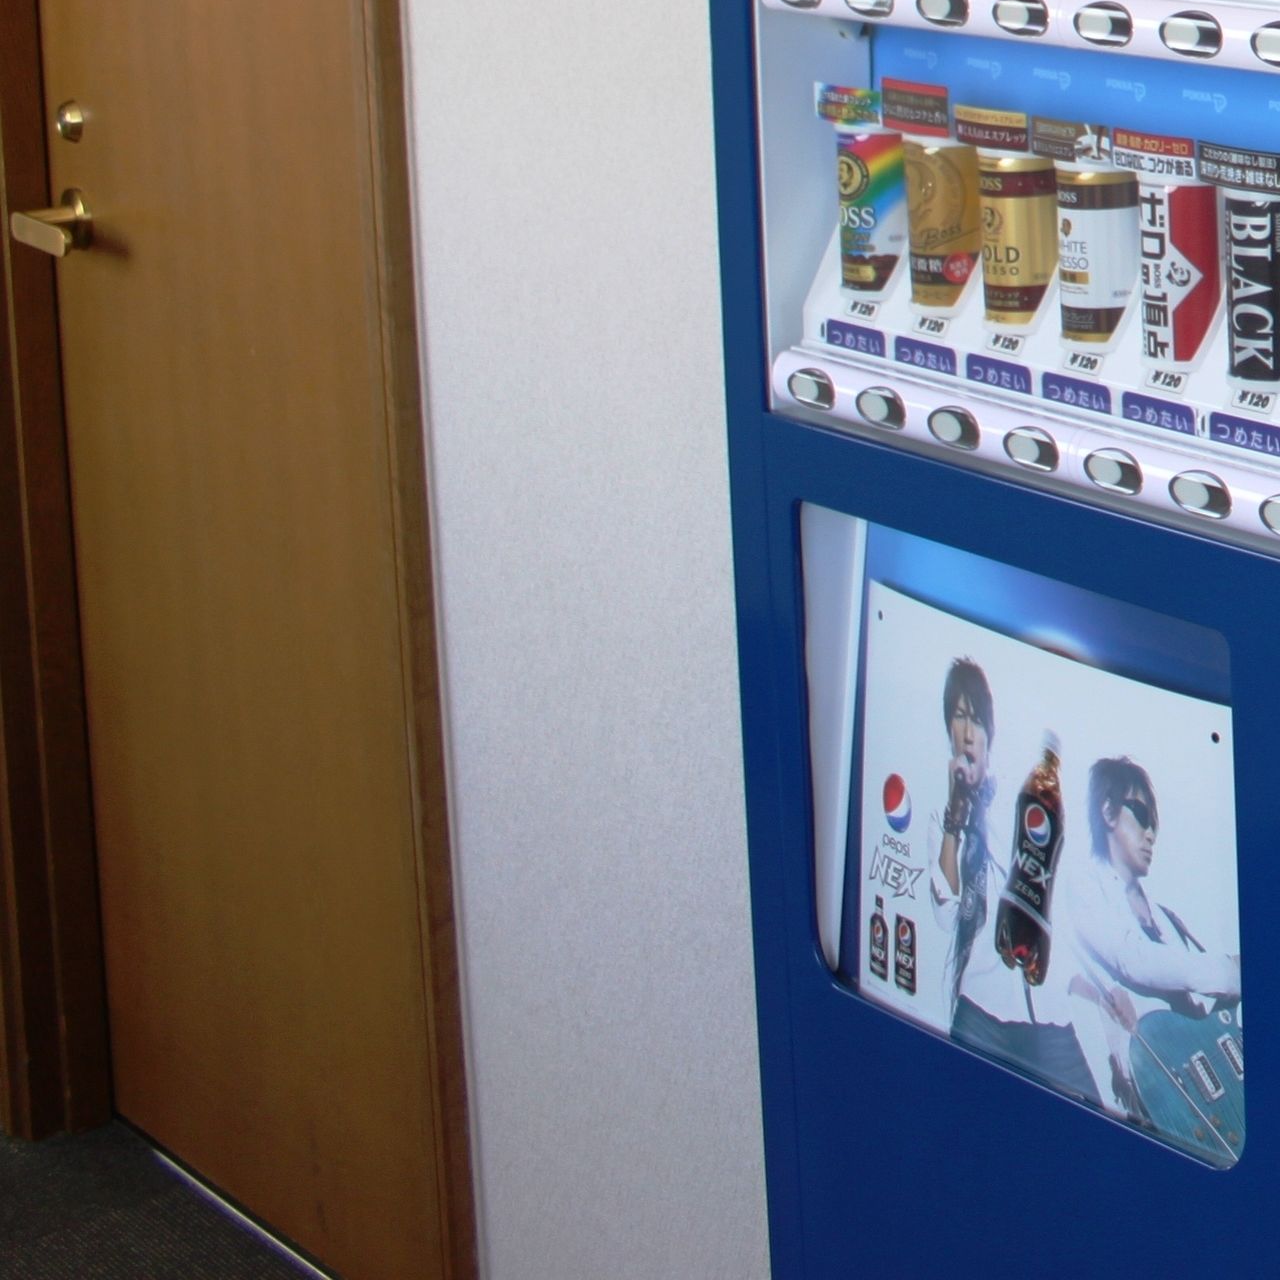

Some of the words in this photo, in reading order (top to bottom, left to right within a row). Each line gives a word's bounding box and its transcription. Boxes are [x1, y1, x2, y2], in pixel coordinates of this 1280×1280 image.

[985, 246, 1020, 264] OLD
[1152, 263, 1161, 289] BOSS
[1231, 212, 1274, 371] BLACK
[850, 303, 875, 317] ¥120
[918, 318, 944, 333] ¥120
[830, 328, 881, 354] つめたい
[992, 335, 1020, 351] ¥120
[900, 346, 952, 372] つめたい
[1068, 354, 1099, 371] ¥120
[971, 363, 1027, 390] つめたい
[1151, 371, 1182, 388] ¥120
[1048, 382, 1105, 411] つめたい
[1239, 390, 1270, 409] ¥120
[1130, 404, 1190, 432] つめたい
[1216, 422, 1280, 454] つめたい
[882, 833, 912, 858] pepsi
[869, 844, 925, 900] NEX
[1011, 850, 1053, 889] NEX
[1014, 880, 1042, 906] ZERO
